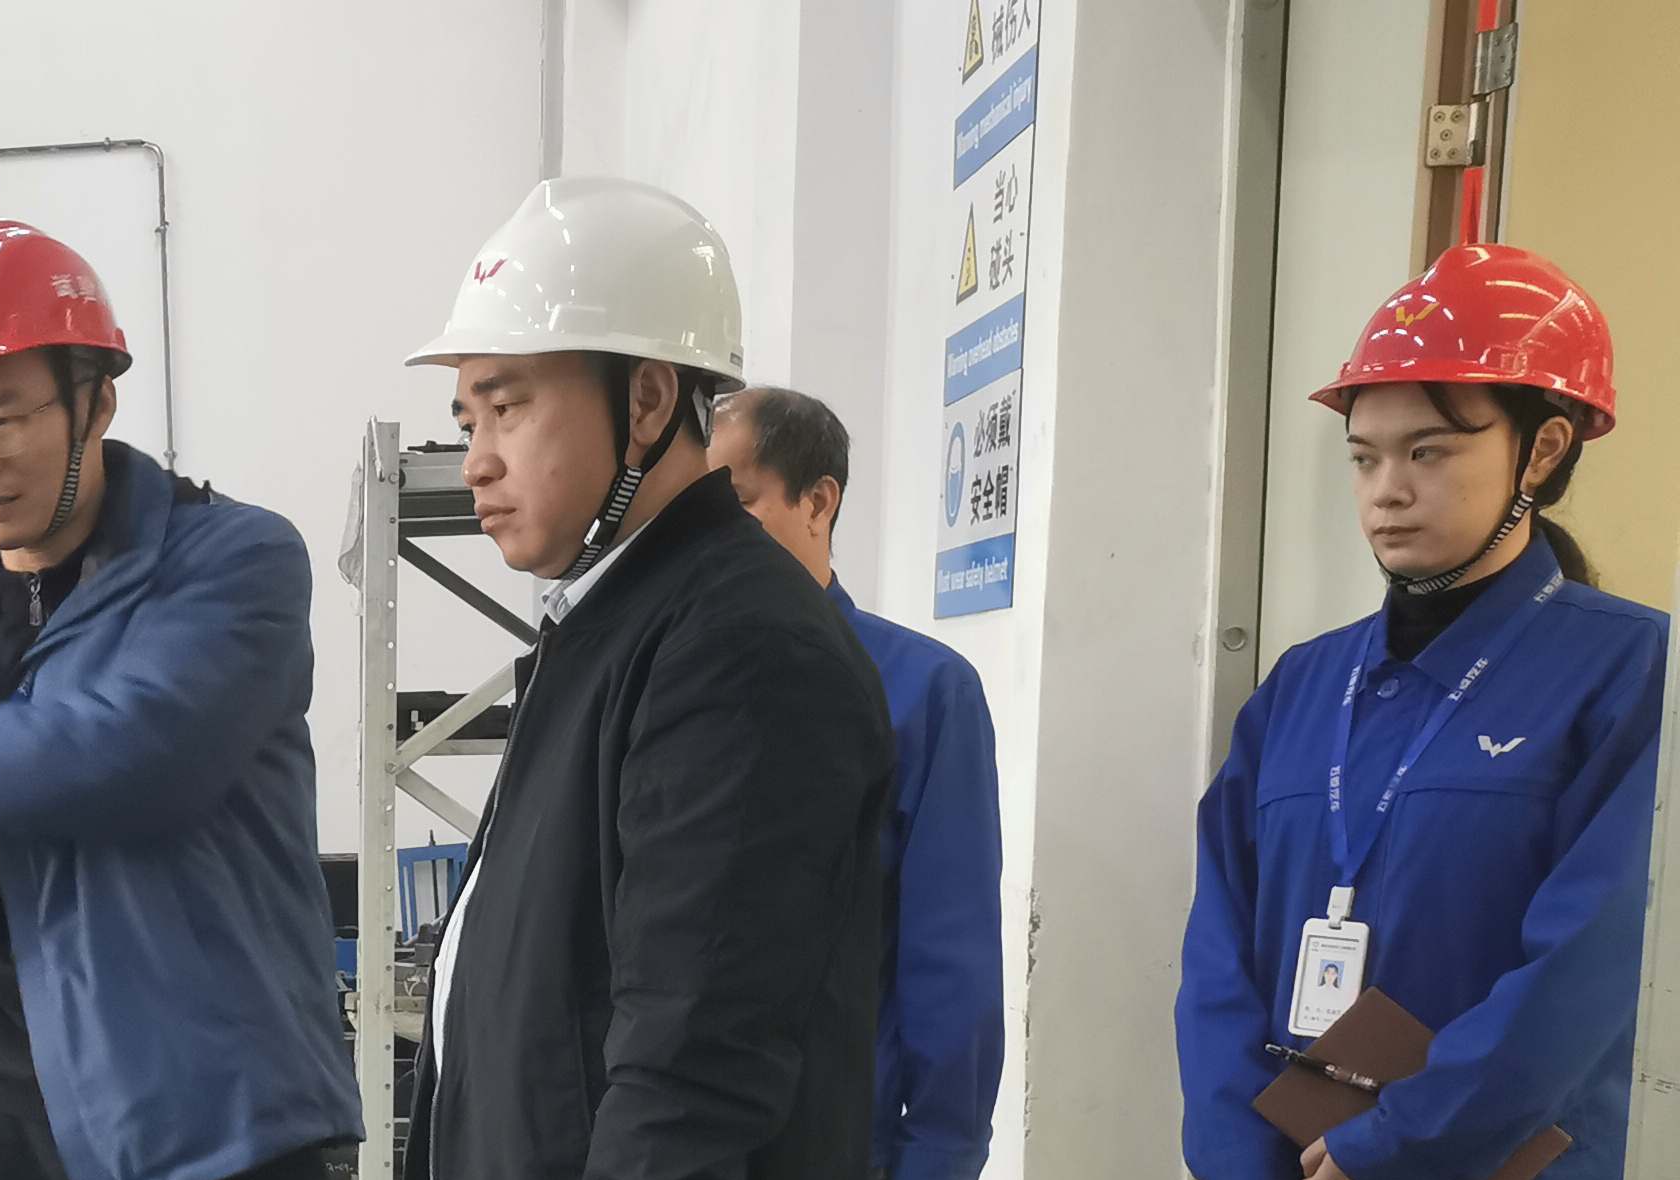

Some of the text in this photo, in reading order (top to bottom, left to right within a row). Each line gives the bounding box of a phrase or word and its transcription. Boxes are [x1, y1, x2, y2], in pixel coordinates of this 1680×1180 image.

[993, 163, 1018, 224] 当心
[989, 229, 1014, 291] 碰头
[973, 394, 1012, 459] 必须戴
[970, 464, 1009, 527] 安全帽
[965, 560, 984, 591] safety
[984, 556, 1008, 584] helmet
